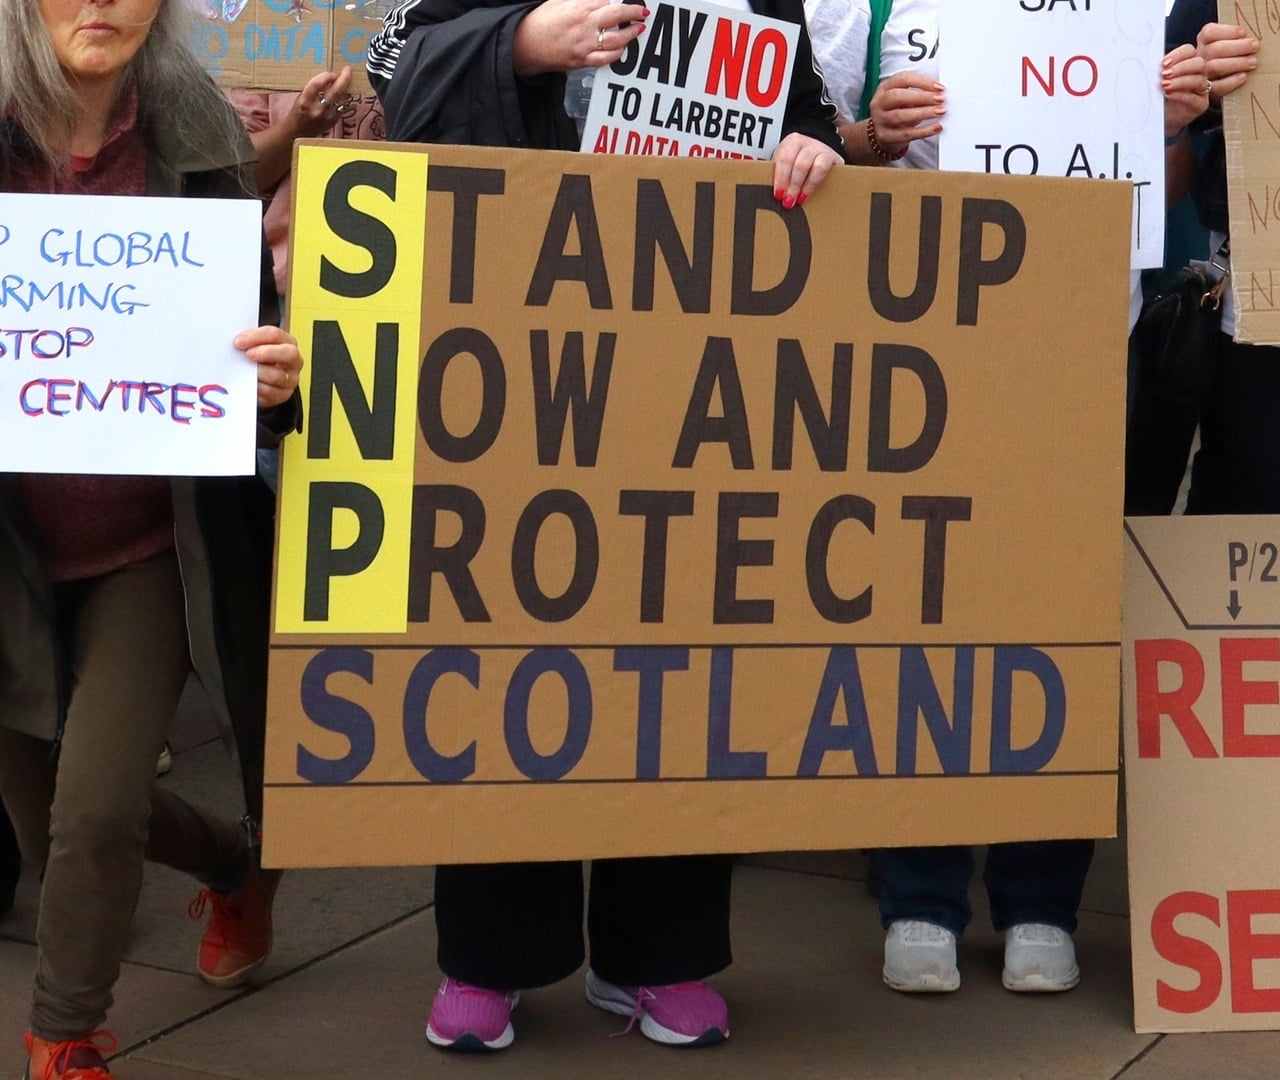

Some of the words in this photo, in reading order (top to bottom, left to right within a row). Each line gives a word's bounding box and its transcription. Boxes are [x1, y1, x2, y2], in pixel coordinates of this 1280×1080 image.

[245, 22, 325, 65] DATA
[705, 17, 788, 108] NO
[1021, 55, 1098, 98] NO
[594, 126, 619, 154] AI
[607, 83, 641, 121] TO
[649, 93, 773, 149] LARBERT
[976, 143, 1039, 176] TO
[1065, 143, 1133, 179] A.I.
[40, 227, 204, 268] GLOBAL
[318, 159, 813, 317] STAND
[867, 190, 1026, 326] UP
[20, 378, 229, 424] CENTRES
[306, 320, 616, 468] NOW
[672, 337, 948, 473] AND
[303, 481, 972, 625] PROTECT
[296, 646, 1066, 783] SCOTLAND
